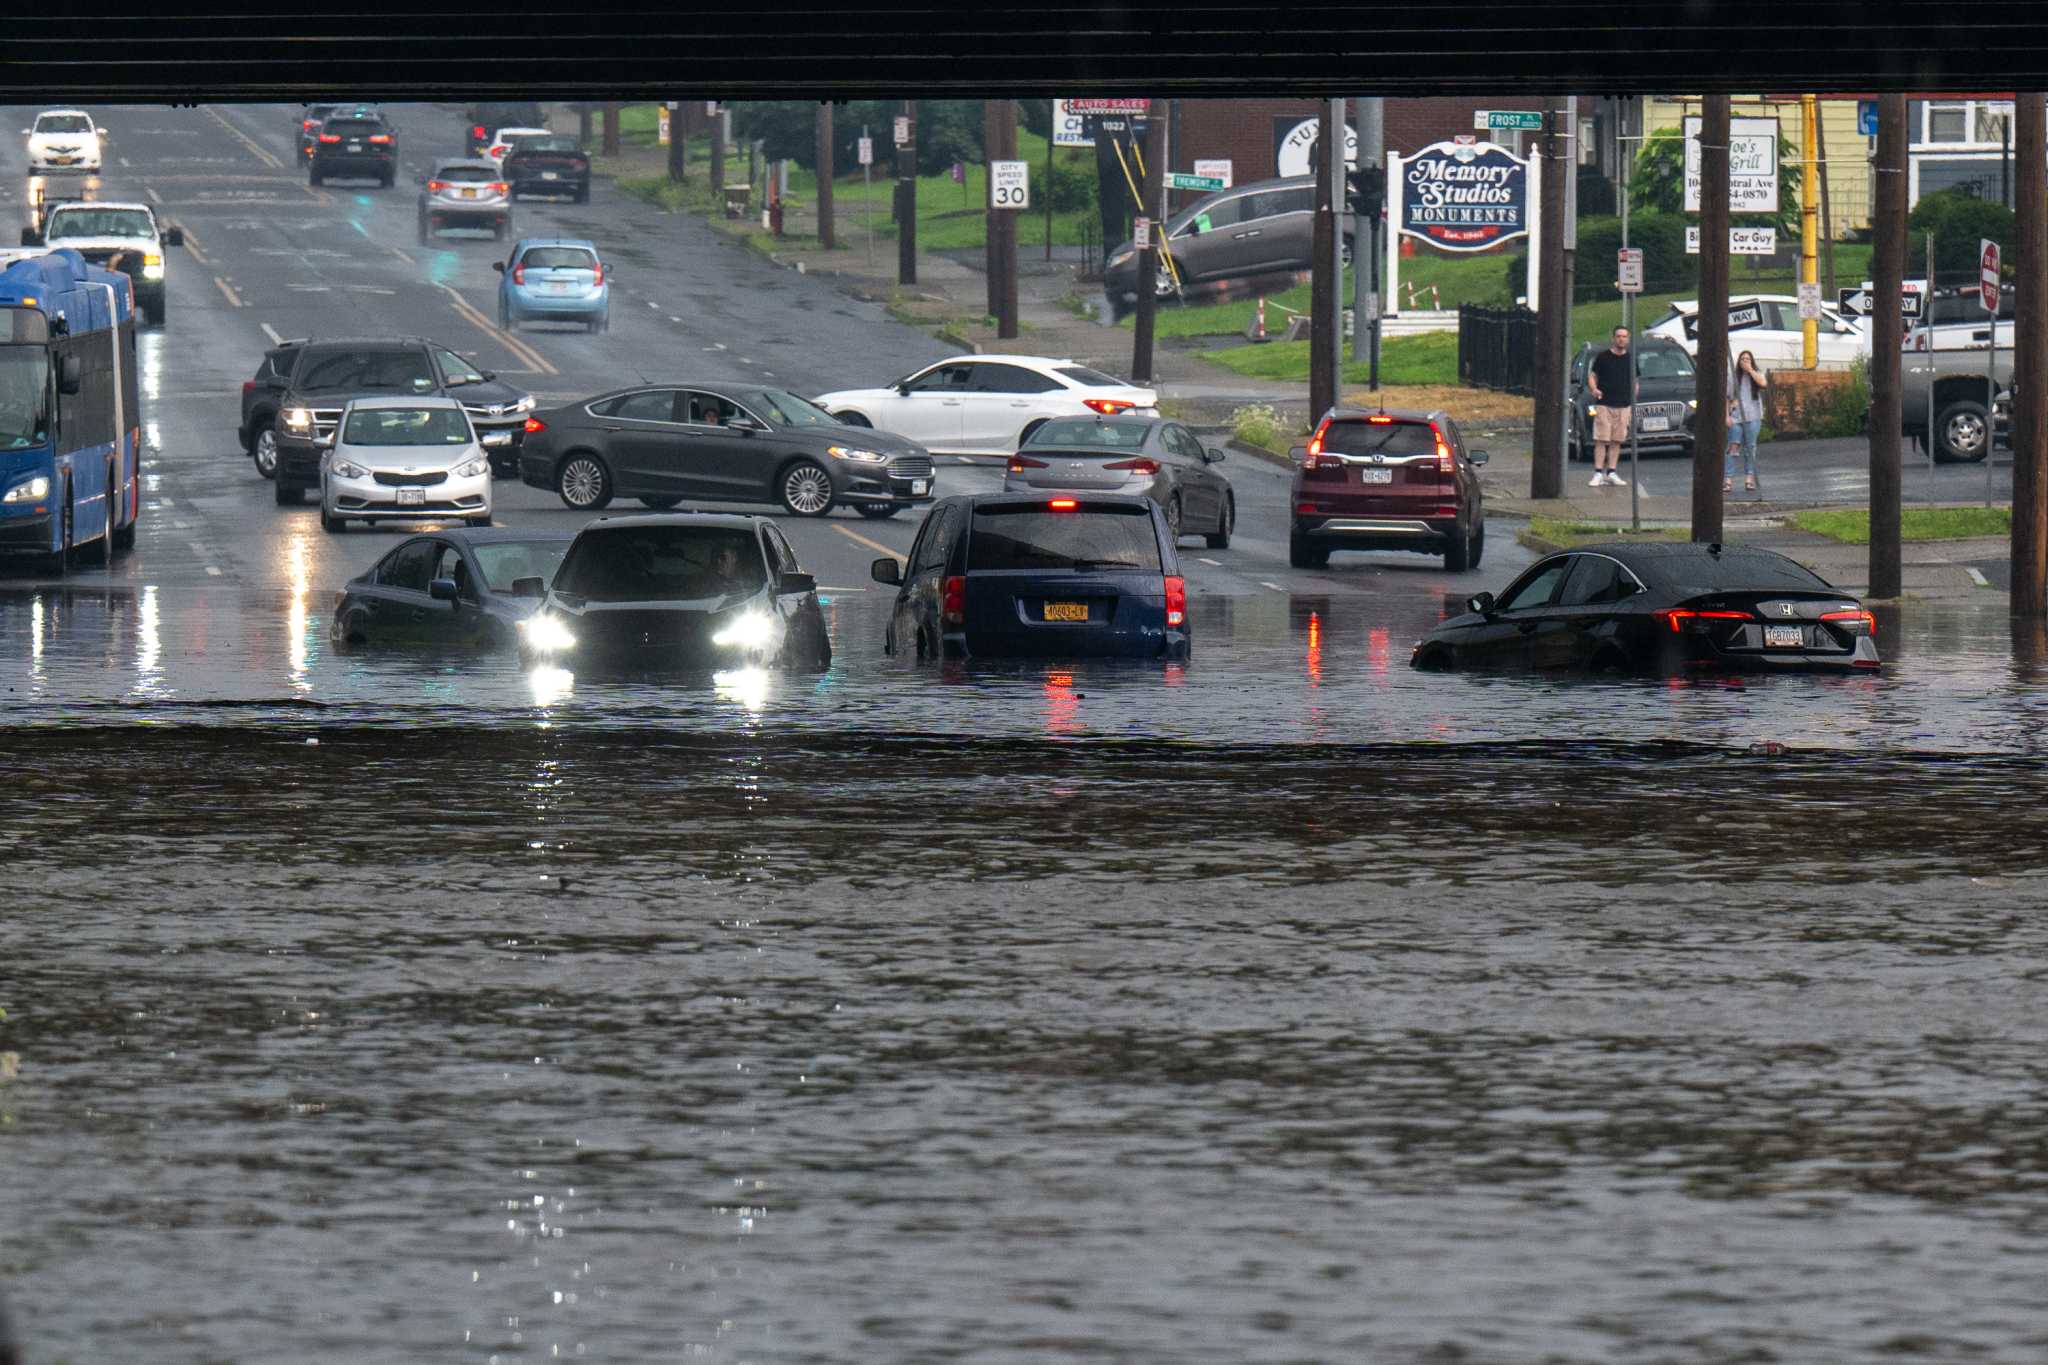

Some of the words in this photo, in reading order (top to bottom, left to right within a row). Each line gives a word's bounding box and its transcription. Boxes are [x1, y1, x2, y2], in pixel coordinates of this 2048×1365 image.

[1075, 101, 1107, 109] AUTO
[1111, 101, 1146, 109] SALES
[1489, 115, 1521, 127] FROST
[1408, 159, 1520, 187] Memory
[1756, 178, 1774, 188] Ave
[997, 187, 1024, 204] 30
[1417, 181, 1512, 208] Studios
[1411, 208, 1518, 222] MONUMENTS
[1733, 232, 1749, 243] Car
[1752, 232, 1772, 245] Guy
[1732, 310, 1754, 323] WAY
